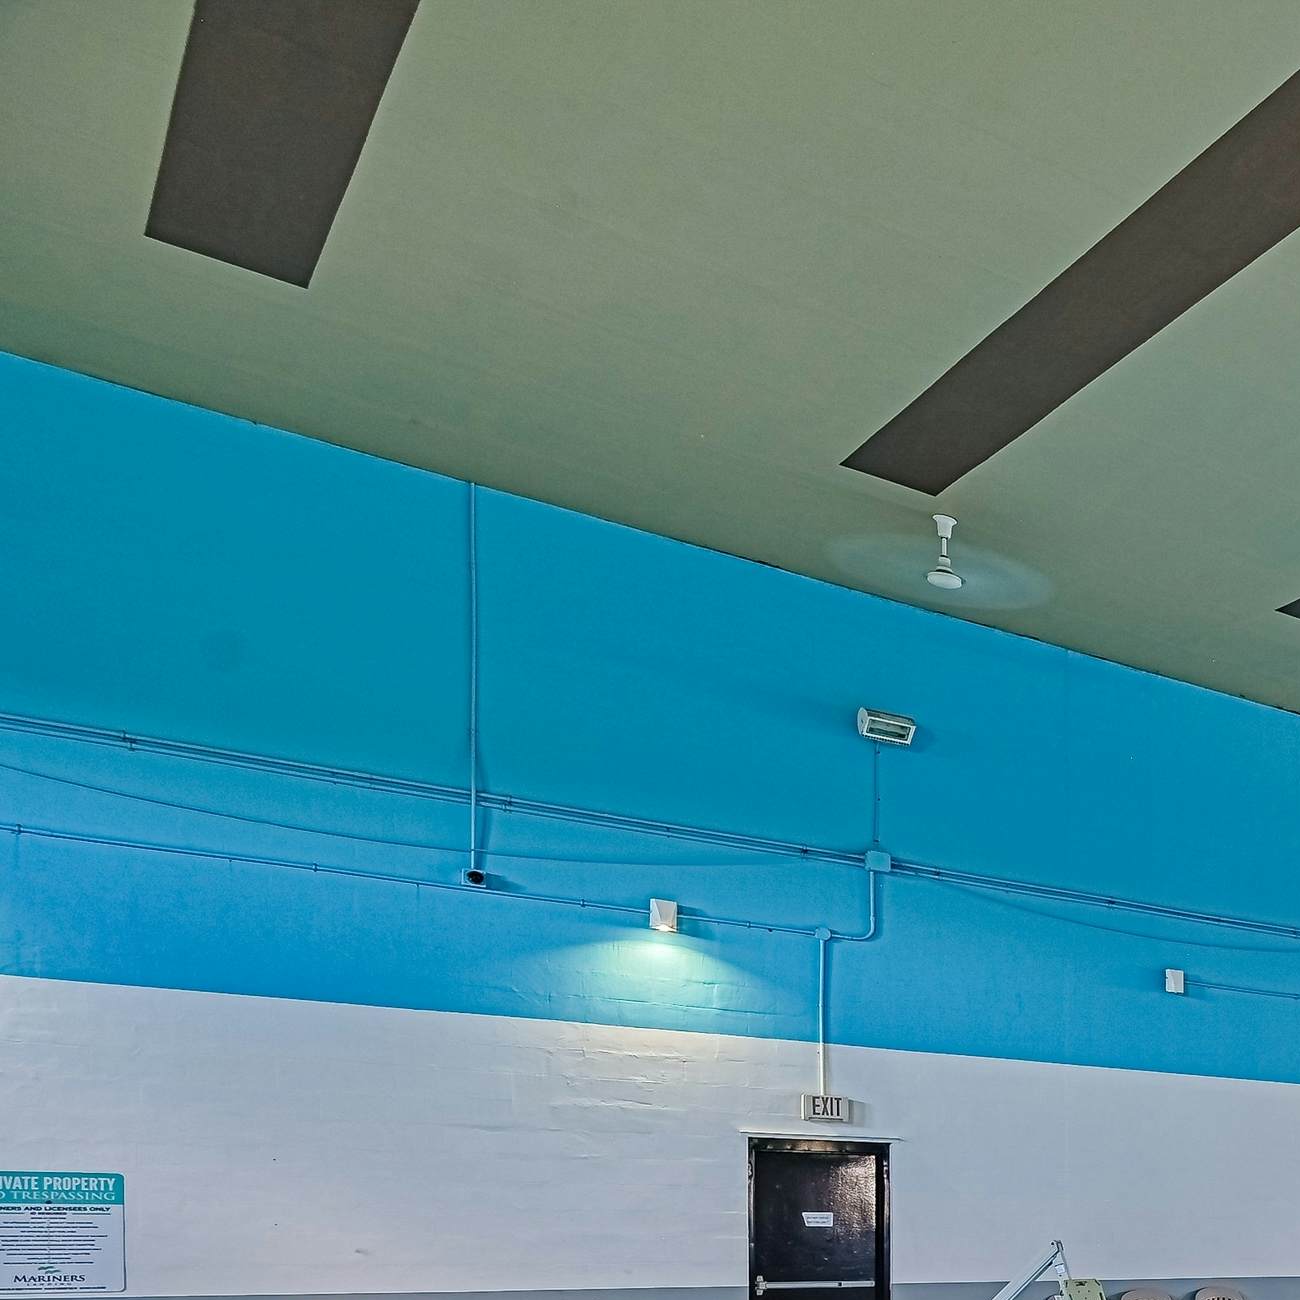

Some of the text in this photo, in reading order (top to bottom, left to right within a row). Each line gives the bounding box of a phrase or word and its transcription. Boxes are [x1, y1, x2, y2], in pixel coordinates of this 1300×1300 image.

[812, 1096, 842, 1117] EXIT
[0, 1175, 116, 1191] IVATE PROPERTY
[10, 1190, 115, 1201] TRESPASSING
[13, 1274, 86, 1283] MARINERS
